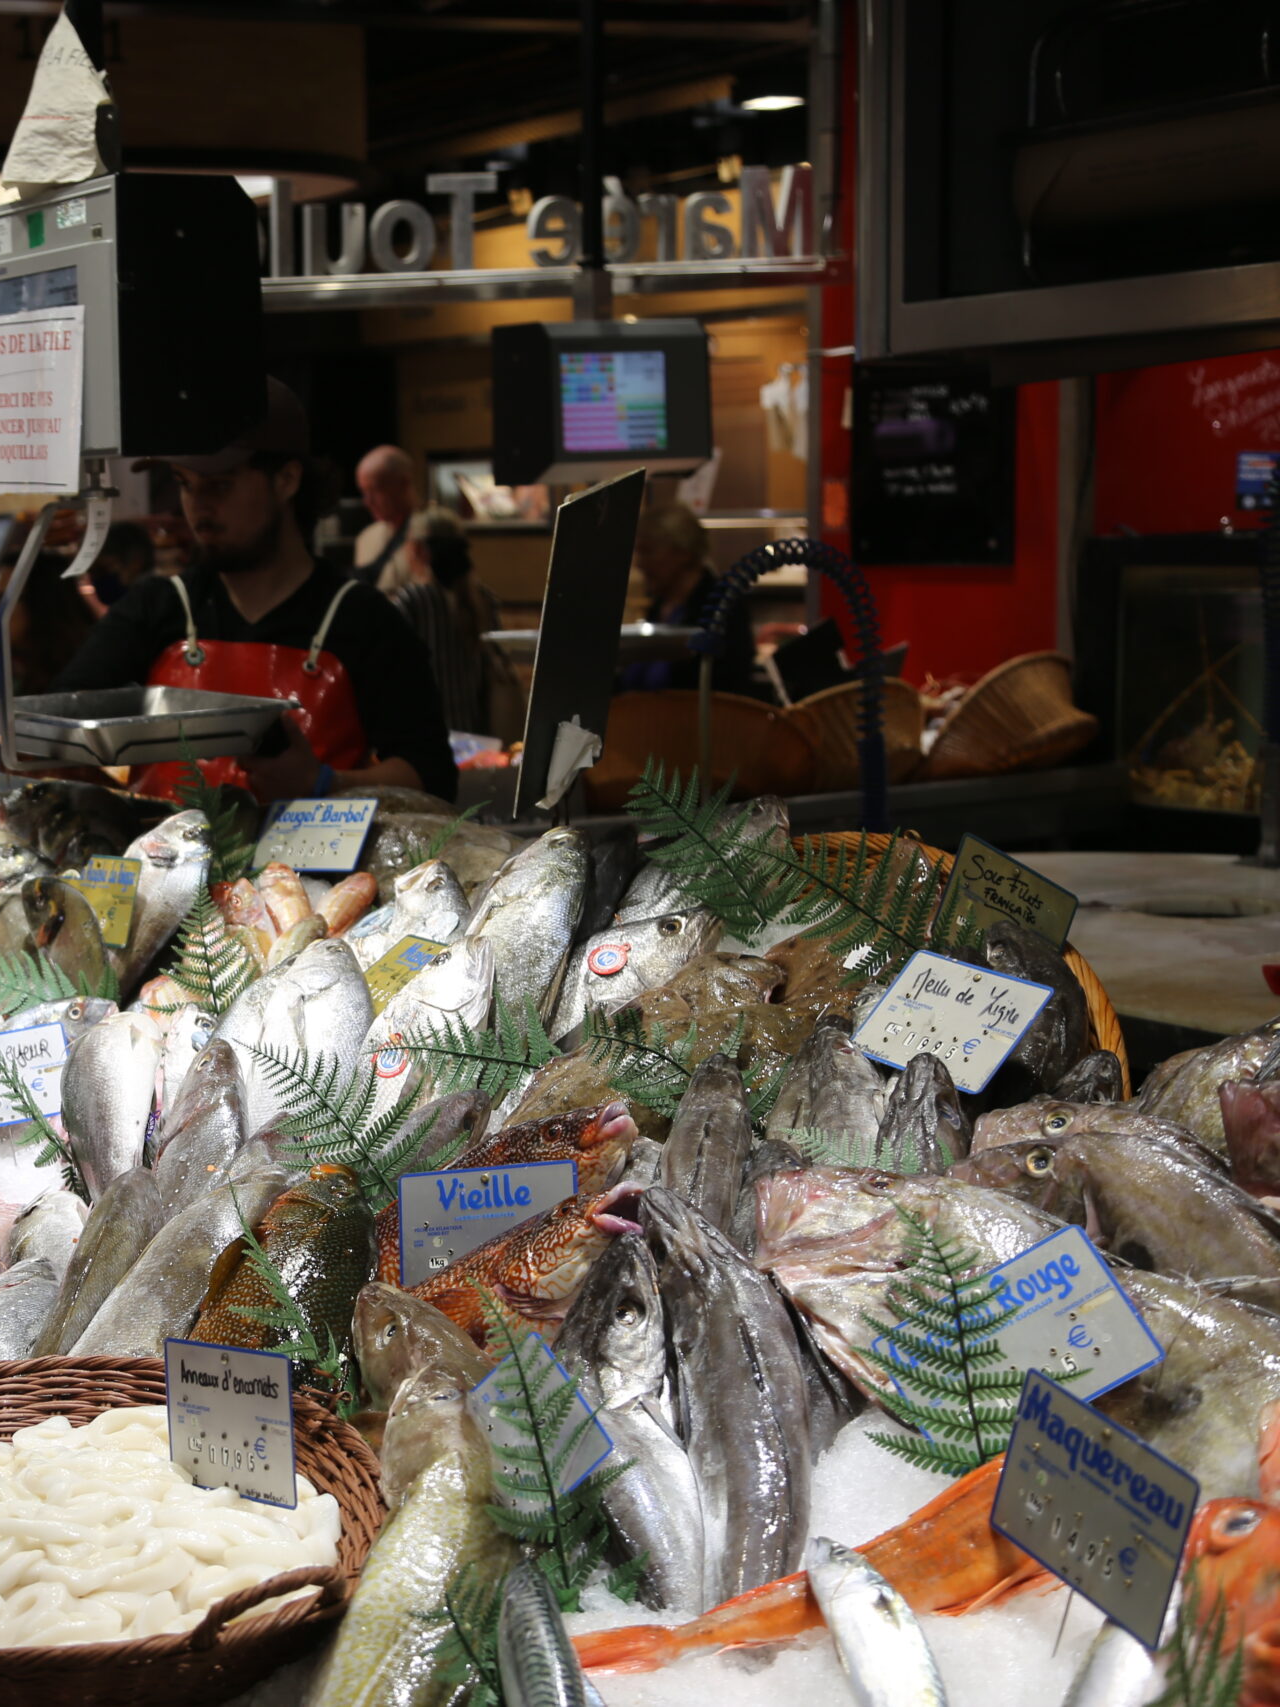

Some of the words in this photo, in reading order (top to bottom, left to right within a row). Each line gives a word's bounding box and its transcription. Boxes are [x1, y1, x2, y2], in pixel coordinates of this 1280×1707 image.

[17, 22, 128, 61] 11
[8, 333, 26, 354] DE
[43, 330, 72, 351] FILE
[22, 392, 36, 408] DE
[320, 803, 369, 823] Barbet
[955, 986, 974, 1006] de
[436, 1173, 533, 1212] Vieille
[430, 1257, 445, 1268] 1kg
[988, 1253, 1081, 1314] Rouge
[1067, 1324, 1093, 1349] €
[180, 1359, 219, 1388] Anneaux
[253, 1436, 267, 1460] €
[1022, 1383, 1185, 1530] Maquereau
